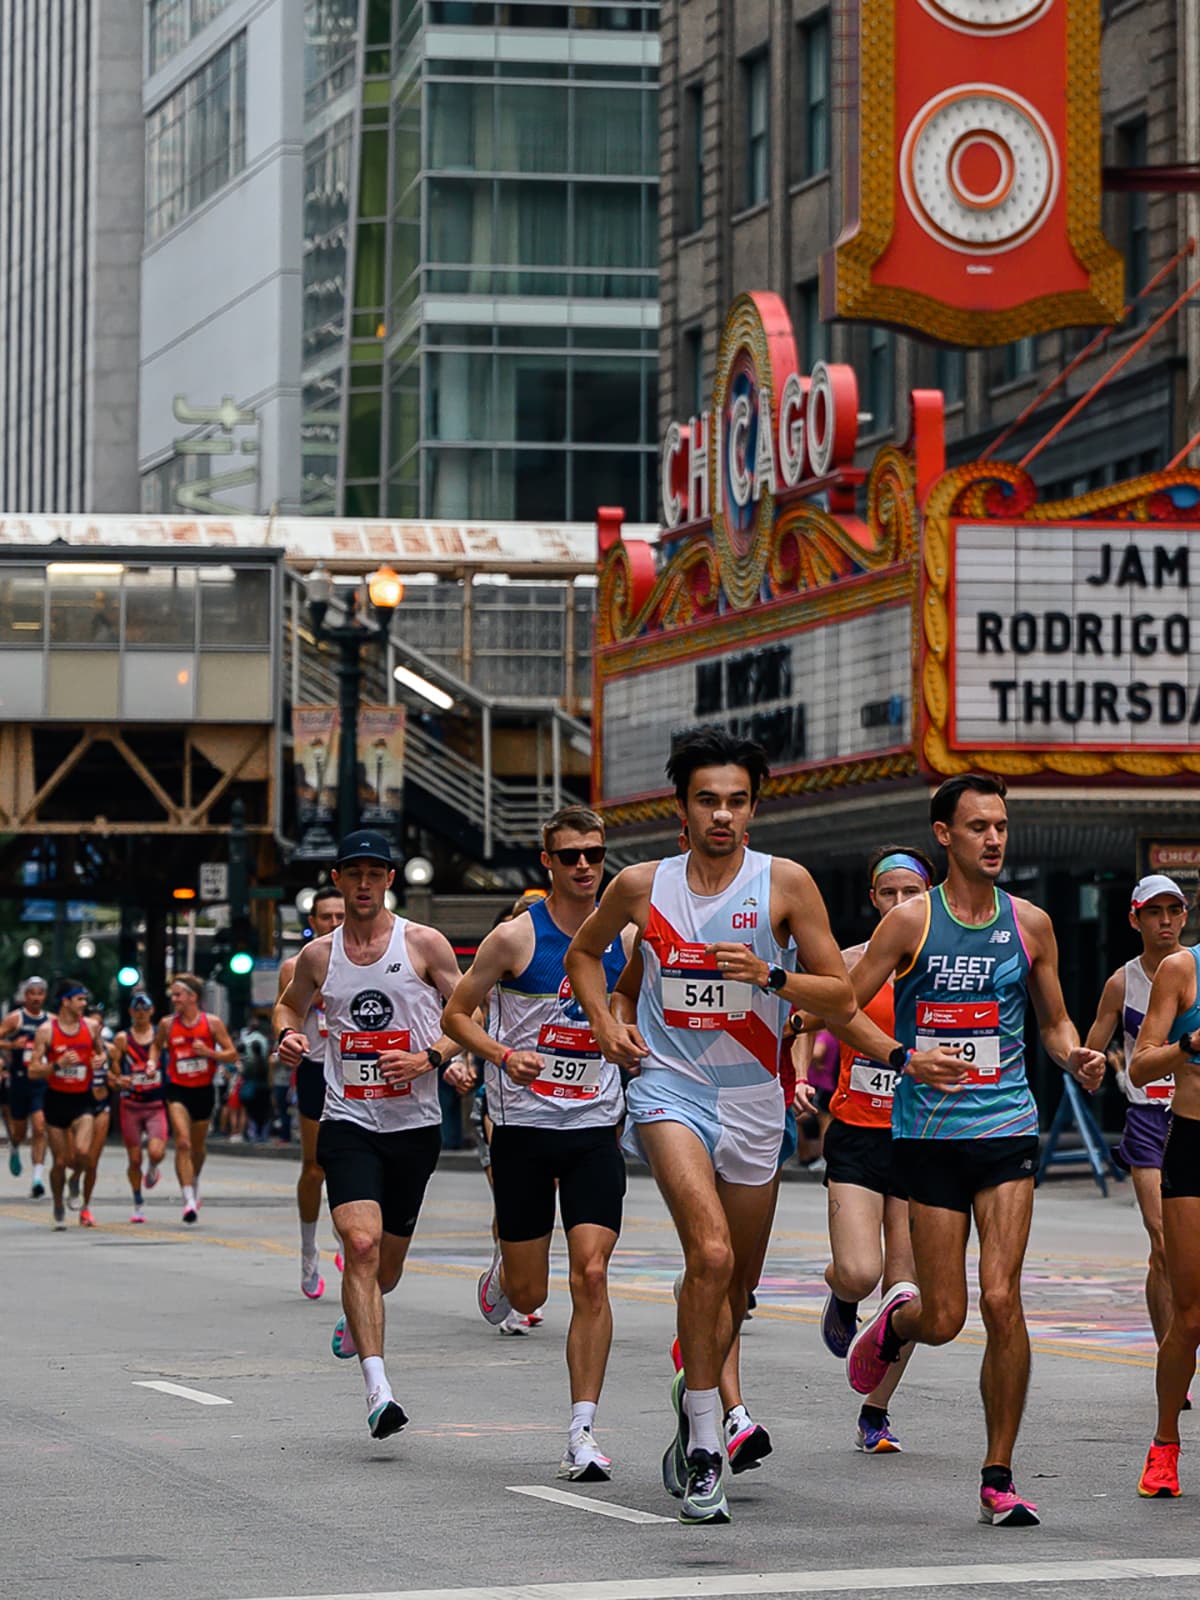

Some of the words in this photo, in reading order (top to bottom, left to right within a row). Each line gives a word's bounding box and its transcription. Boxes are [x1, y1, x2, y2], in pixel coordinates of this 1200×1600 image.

[661, 360, 836, 528] CHICAGO
[1087, 543, 1189, 588] JAM
[977, 612, 1190, 656] RODRIGO
[732, 912, 758, 929] CHI
[927, 955, 996, 974] FLEET
[934, 974, 990, 991] FEET
[685, 984, 724, 1008] 541
[938, 1041, 976, 1064] 19
[552, 1060, 587, 1081] 597
